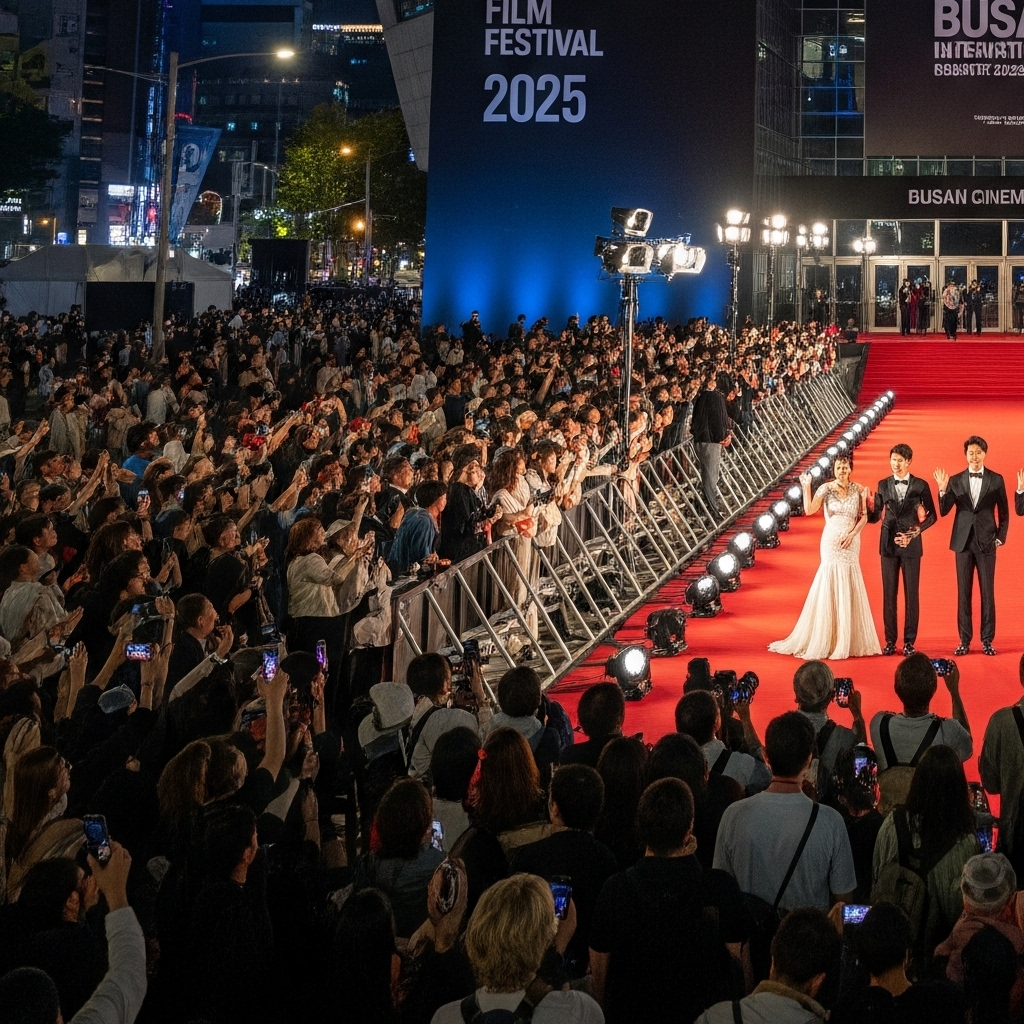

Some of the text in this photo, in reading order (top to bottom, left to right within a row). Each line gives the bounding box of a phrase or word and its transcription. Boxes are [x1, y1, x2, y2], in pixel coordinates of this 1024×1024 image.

[484, 28, 604, 57] FESTIVAL
[483, 73, 587, 123] 2025
[908, 189, 968, 205] BUSAN
